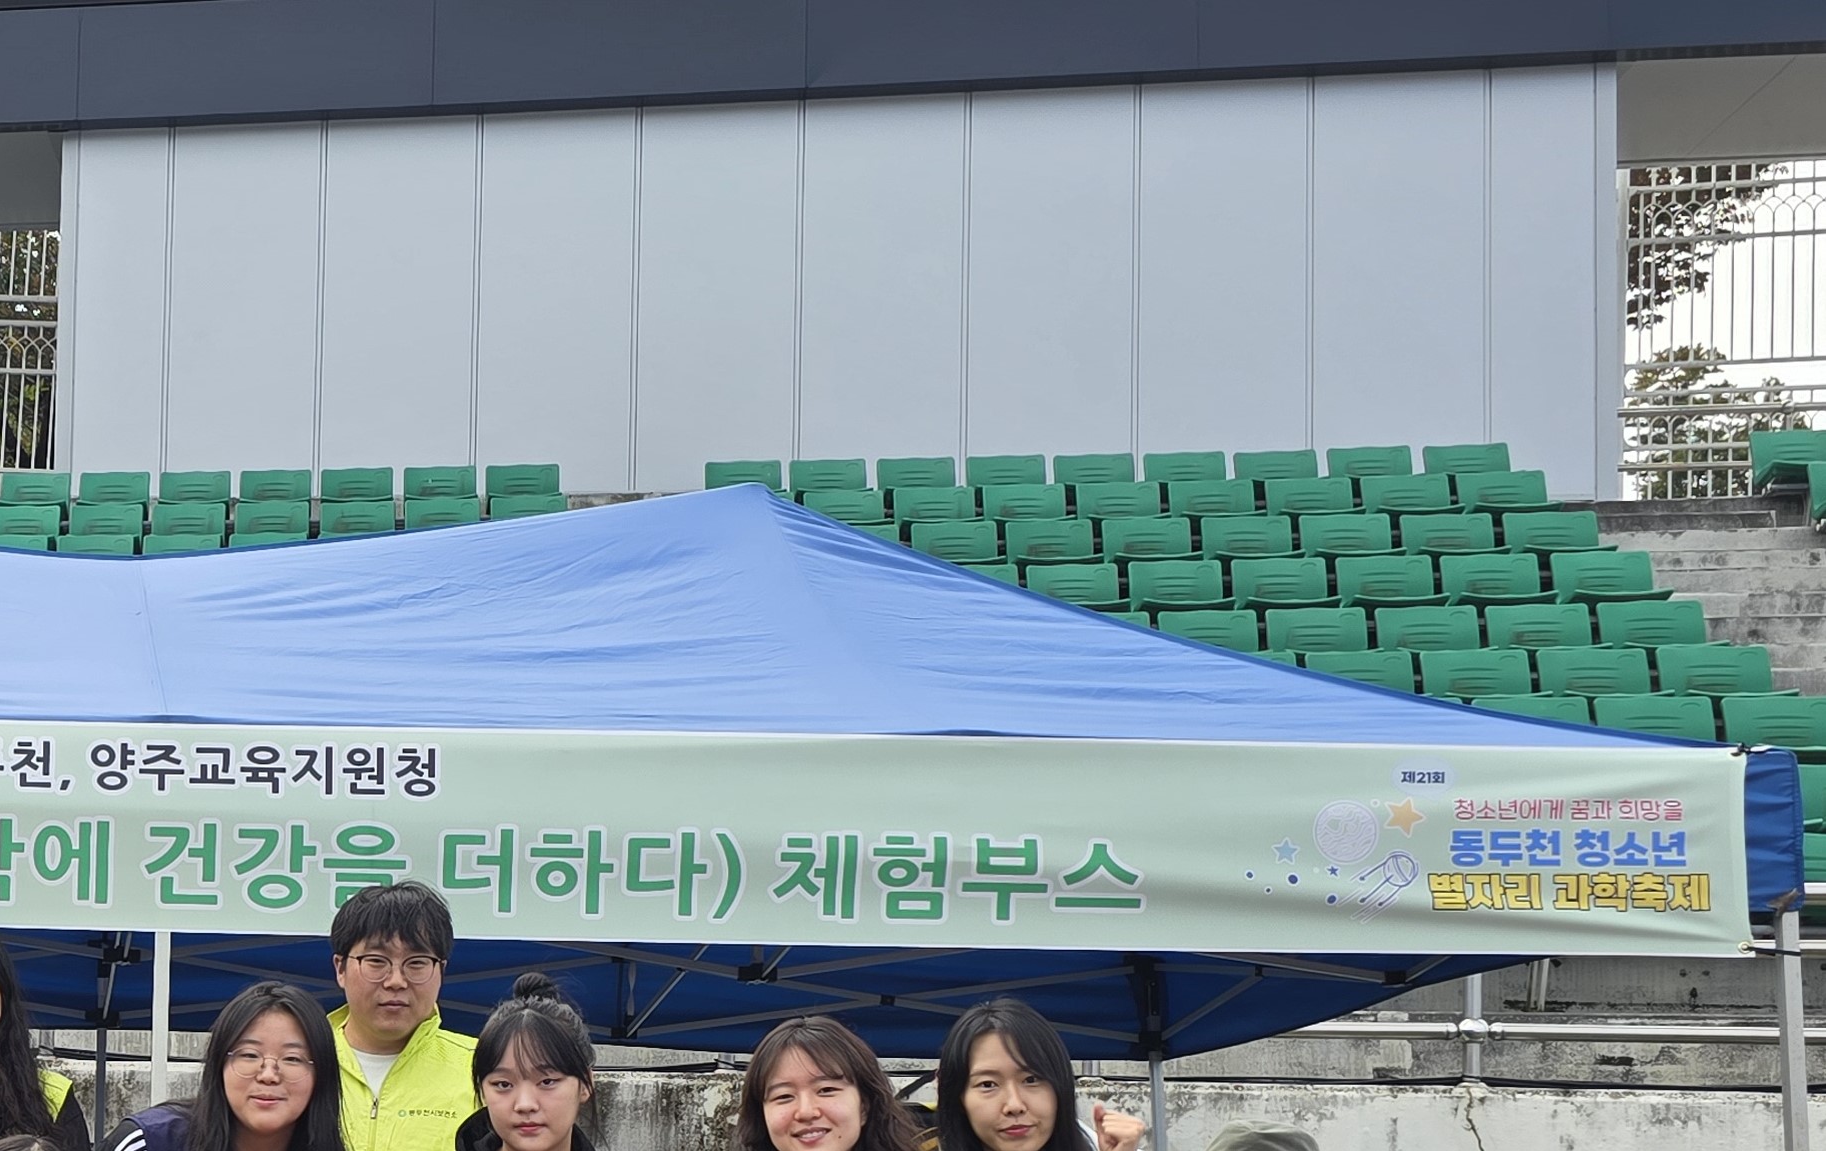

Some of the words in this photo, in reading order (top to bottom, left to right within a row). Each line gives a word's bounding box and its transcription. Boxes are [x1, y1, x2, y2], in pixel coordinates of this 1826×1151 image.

[91, 742, 438, 797] 양주교육지원청
[1401, 770, 1445, 786] 제21회
[1454, 799, 1564, 821] 청소년에게
[1569, 800, 1612, 821] 꿈과
[1618, 800, 1683, 822] 희망을
[1449, 829, 1561, 869] 동두천
[1574, 829, 1686, 869] 청소년
[144, 822, 408, 910] 건강을
[442, 828, 743, 920] 더하다)
[773, 834, 1143, 922] 체험부스
[1428, 873, 1541, 911] 별자리
[1553, 873, 1711, 912] 과학축제
